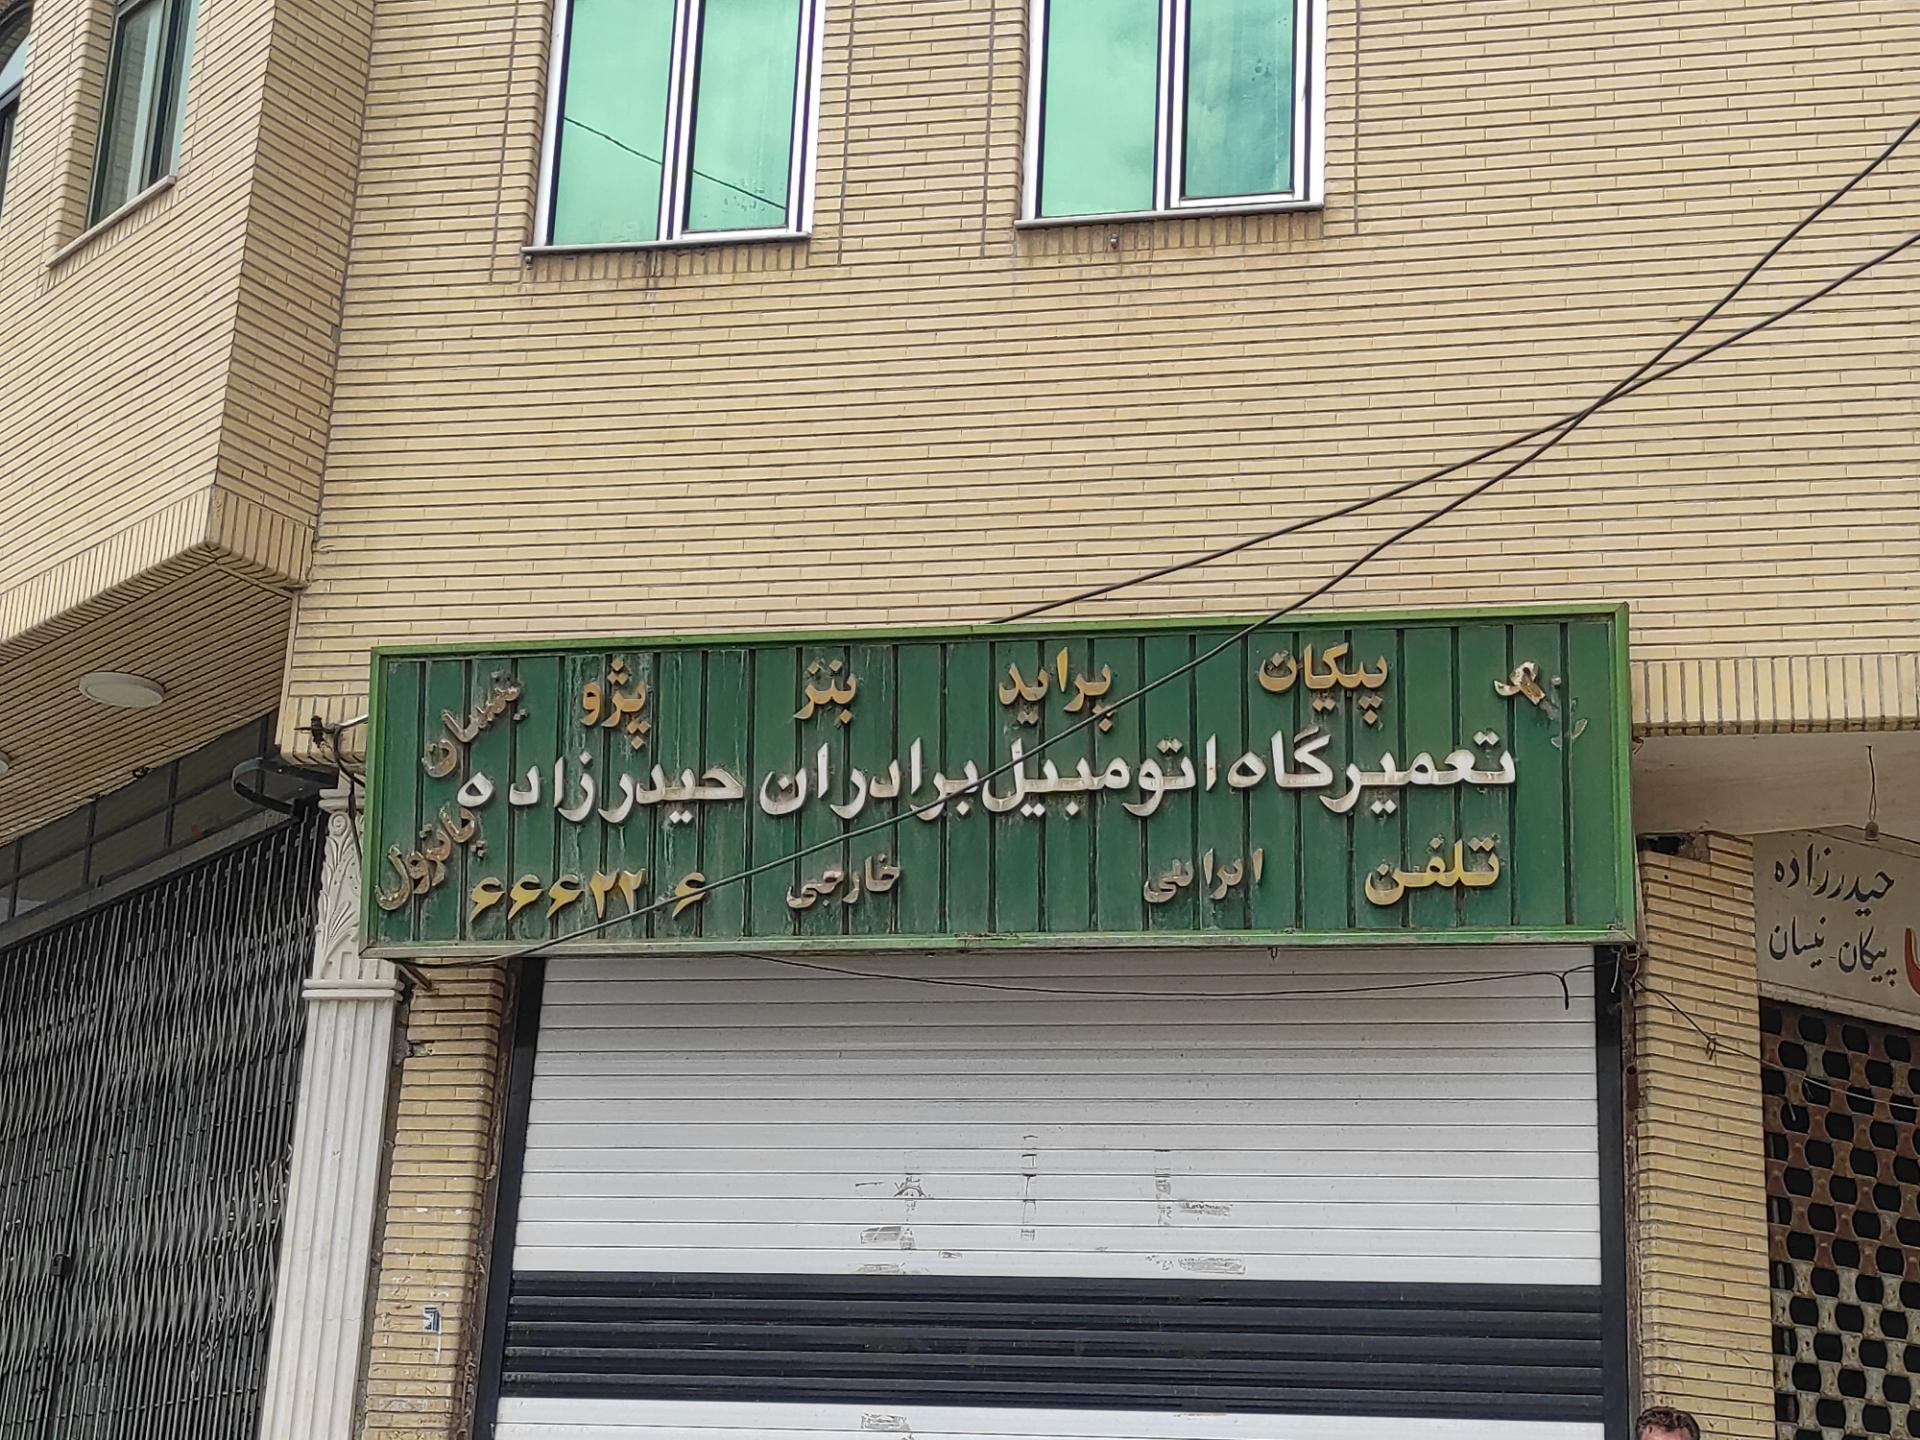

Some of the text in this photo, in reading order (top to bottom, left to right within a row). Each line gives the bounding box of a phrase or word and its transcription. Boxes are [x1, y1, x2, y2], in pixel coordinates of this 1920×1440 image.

[580, 658, 651, 750] پژو
[793, 658, 858, 724] بنز
[999, 646, 1115, 733] پراید
[1258, 642, 1388, 726] پیکان
[457, 726, 1516, 824] تعمیرگاه اتومبیل برادران حیدرزاده
[786, 853, 901, 909] خارجی
[1365, 836, 1500, 906] تلفن
[1774, 843, 1895, 916] حیدرزاده
[1769, 916, 1825, 968] نیسان
[1838, 926, 1897, 987] پیکان
